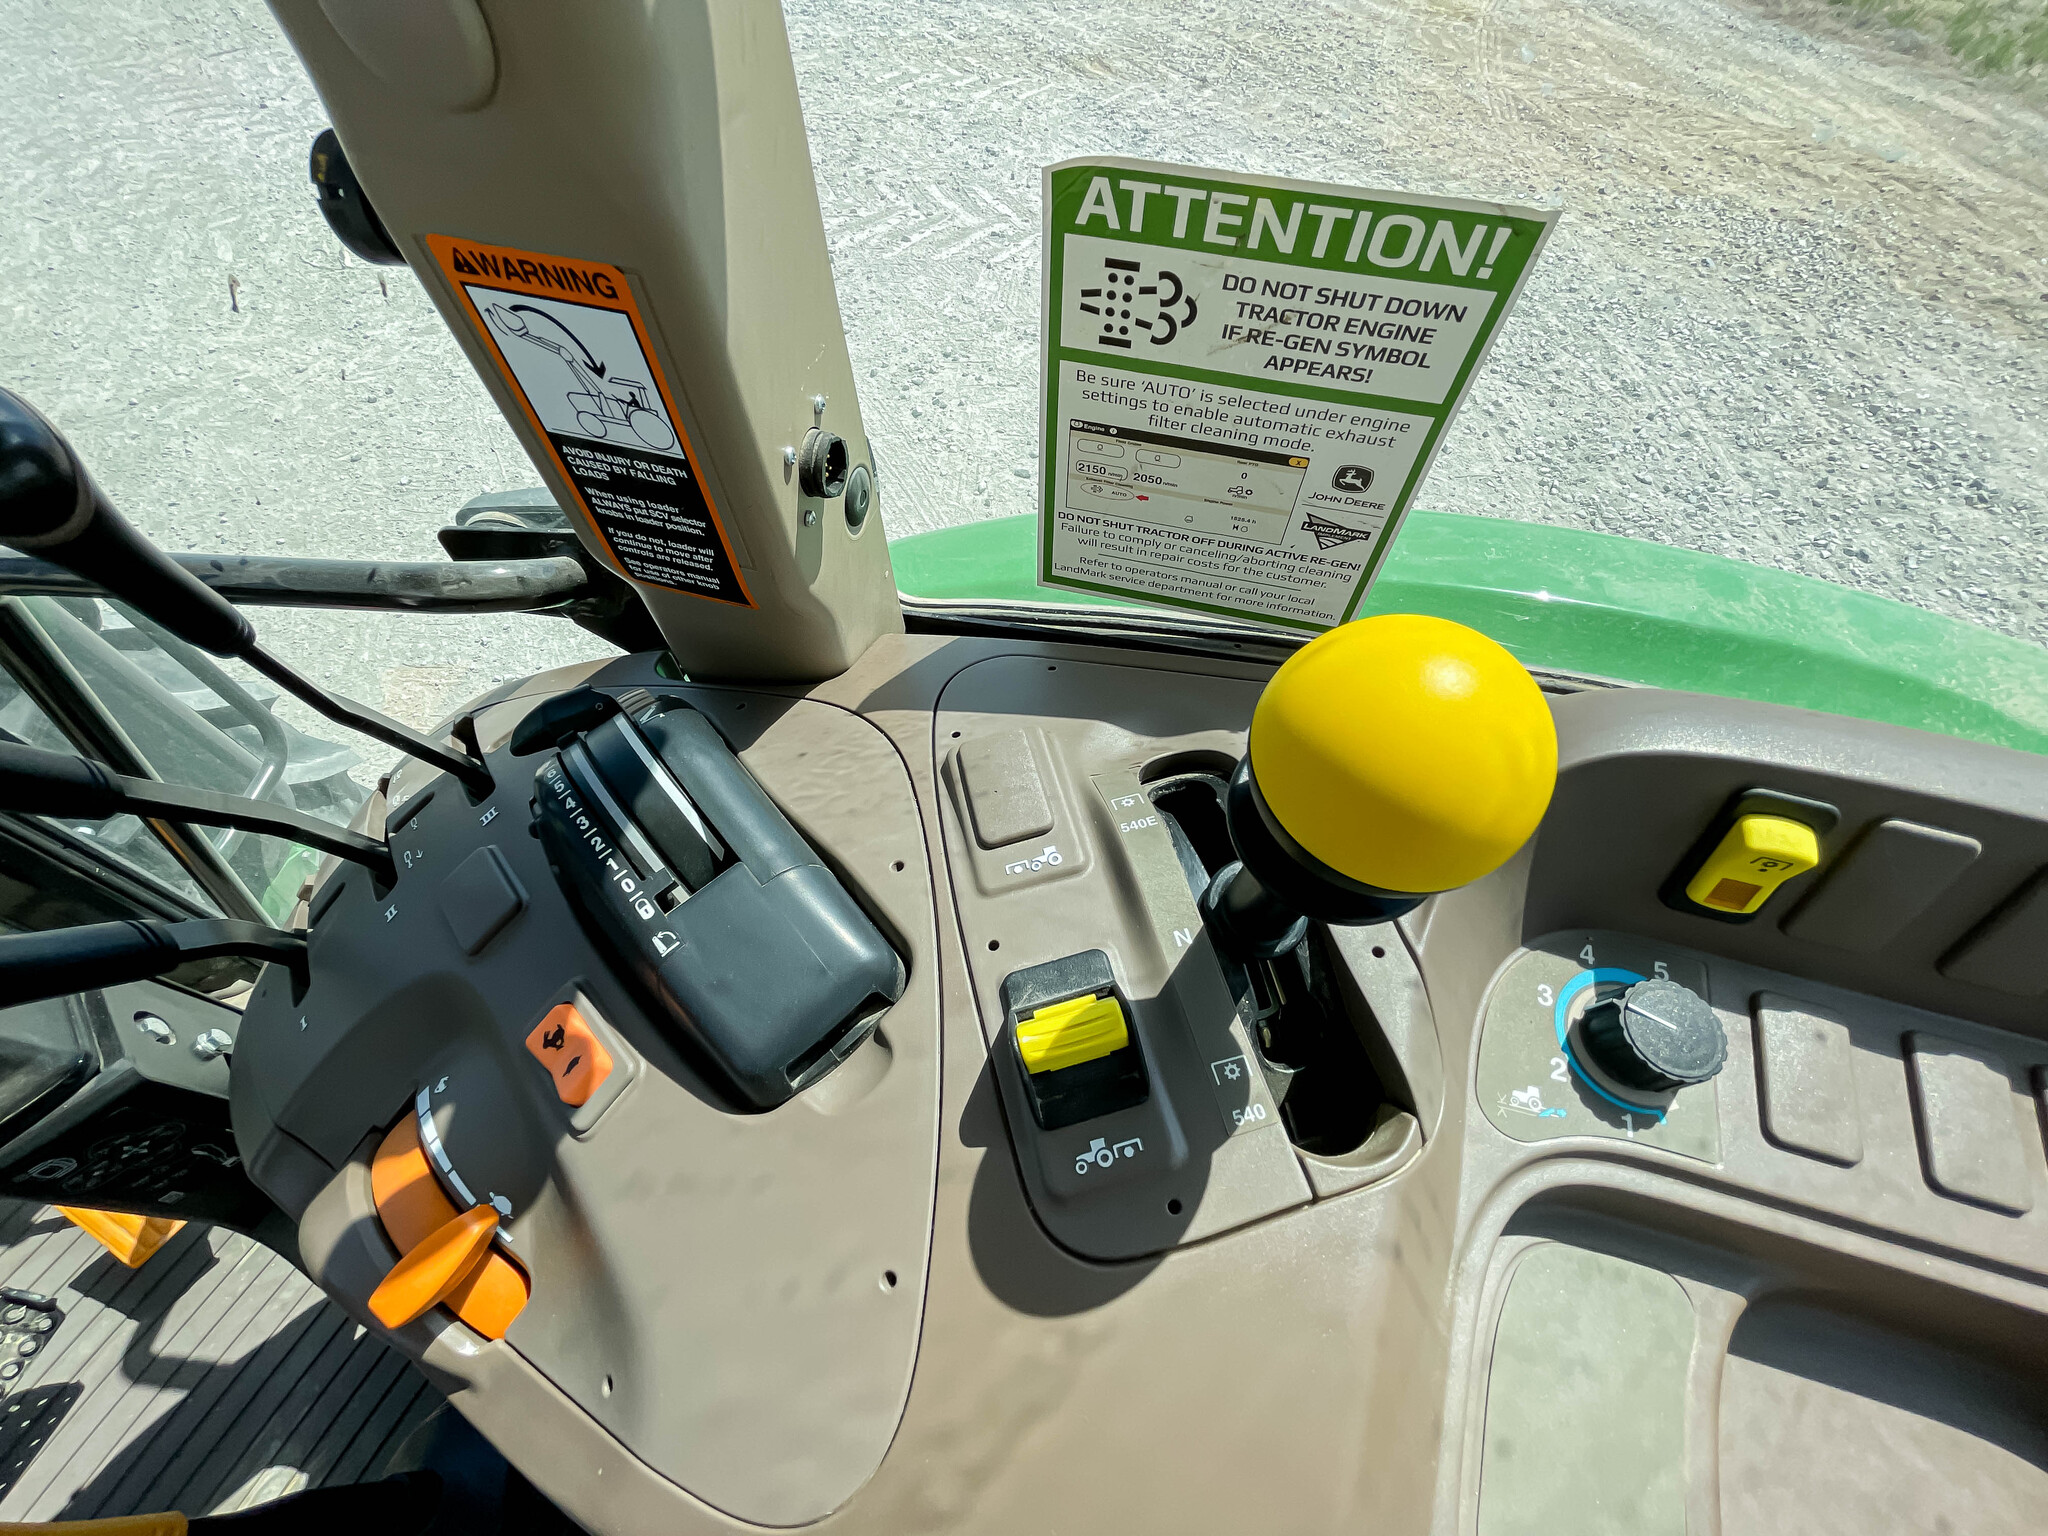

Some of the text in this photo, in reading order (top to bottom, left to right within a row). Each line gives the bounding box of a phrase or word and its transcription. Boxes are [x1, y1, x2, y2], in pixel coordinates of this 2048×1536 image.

[1074, 176, 1513, 279] ATTENTION!
[468, 250, 619, 300] WARNING
[1222, 274, 1468, 323] DO NOT SHUT DOWN
[1236, 301, 1438, 344] TRACTOR ENGINE
[1222, 323, 1431, 369] IF RE-GEN SYMBOL
[1263, 355, 1373, 384] APPEARS!
[1076, 370, 1096, 384] Be
[1101, 375, 1135, 390] sure
[1200, 390, 1213, 402] is
[1218, 395, 1291, 414] selected
[1296, 406, 1347, 423] under
[1350, 415, 1411, 433] engine
[1082, 390, 1396, 448] settings to enable automatic exhaust
[1148, 414, 1314, 452] filter cleaning mode.
[562, 446, 688, 478] AVOID INJURY OR DEATH
[567, 456, 677, 486] CAUSED BY FALLING
[572, 466, 609, 480] LOADS
[1078, 462, 1107, 475] 2150
[1133, 472, 1162, 485] 2050
[584, 486, 679, 513] When using loader
[1111, 490, 1127, 498] AUTO
[1308, 492, 1386, 510] JOHN DEERE
[592, 497, 706, 528] ALWAYS put SCV selector
[595, 506, 705, 536] knobs in loader position.
[616, 530, 633, 538] you
[635, 533, 646, 541] do
[648, 536, 666, 547] not,
[668, 540, 696, 552] loader
[698, 547, 714, 556] will
[1058, 512, 1361, 571] DO NOT SHUT TRACTOR OFF DURING ACTIVE RE-GEN!
[1303, 523, 1370, 539] LANDMARK
[613, 537, 652, 550] continue
[666, 548, 690, 558] move
[692, 554, 714, 564] after
[618, 545, 654, 558] controls
[672, 557, 713, 571] released.
[1061, 522, 1352, 583] Failure to comply or canceling/aborting cleaning
[1077, 537, 1326, 588] will result in repair costs for the customer.
[624, 557, 642, 566] See
[686, 572, 720, 584] manual
[1079, 556, 1315, 605] Refer to operators manual or call your local
[697, 580, 720, 590] knob
[1054, 562, 1336, 621] LandMark service department for more information.
[480, 806, 499, 826] III
[1120, 816, 1158, 833] 540E
[554, 782, 565, 792] 5
[565, 796, 576, 810] 4
[576, 816, 589, 830] 3
[590, 836, 605, 851] 2
[606, 858, 620, 871] 1
[620, 878, 636, 892] 0
[384, 904, 398, 922] II
[1173, 928, 1193, 947] N
[1580, 944, 1595, 964] 4
[1654, 961, 1670, 981] 5
[1537, 983, 1554, 1007] 3
[1550, 1057, 1568, 1082] 2
[1232, 1103, 1267, 1126] 540
[1621, 1113, 1634, 1137] 1
